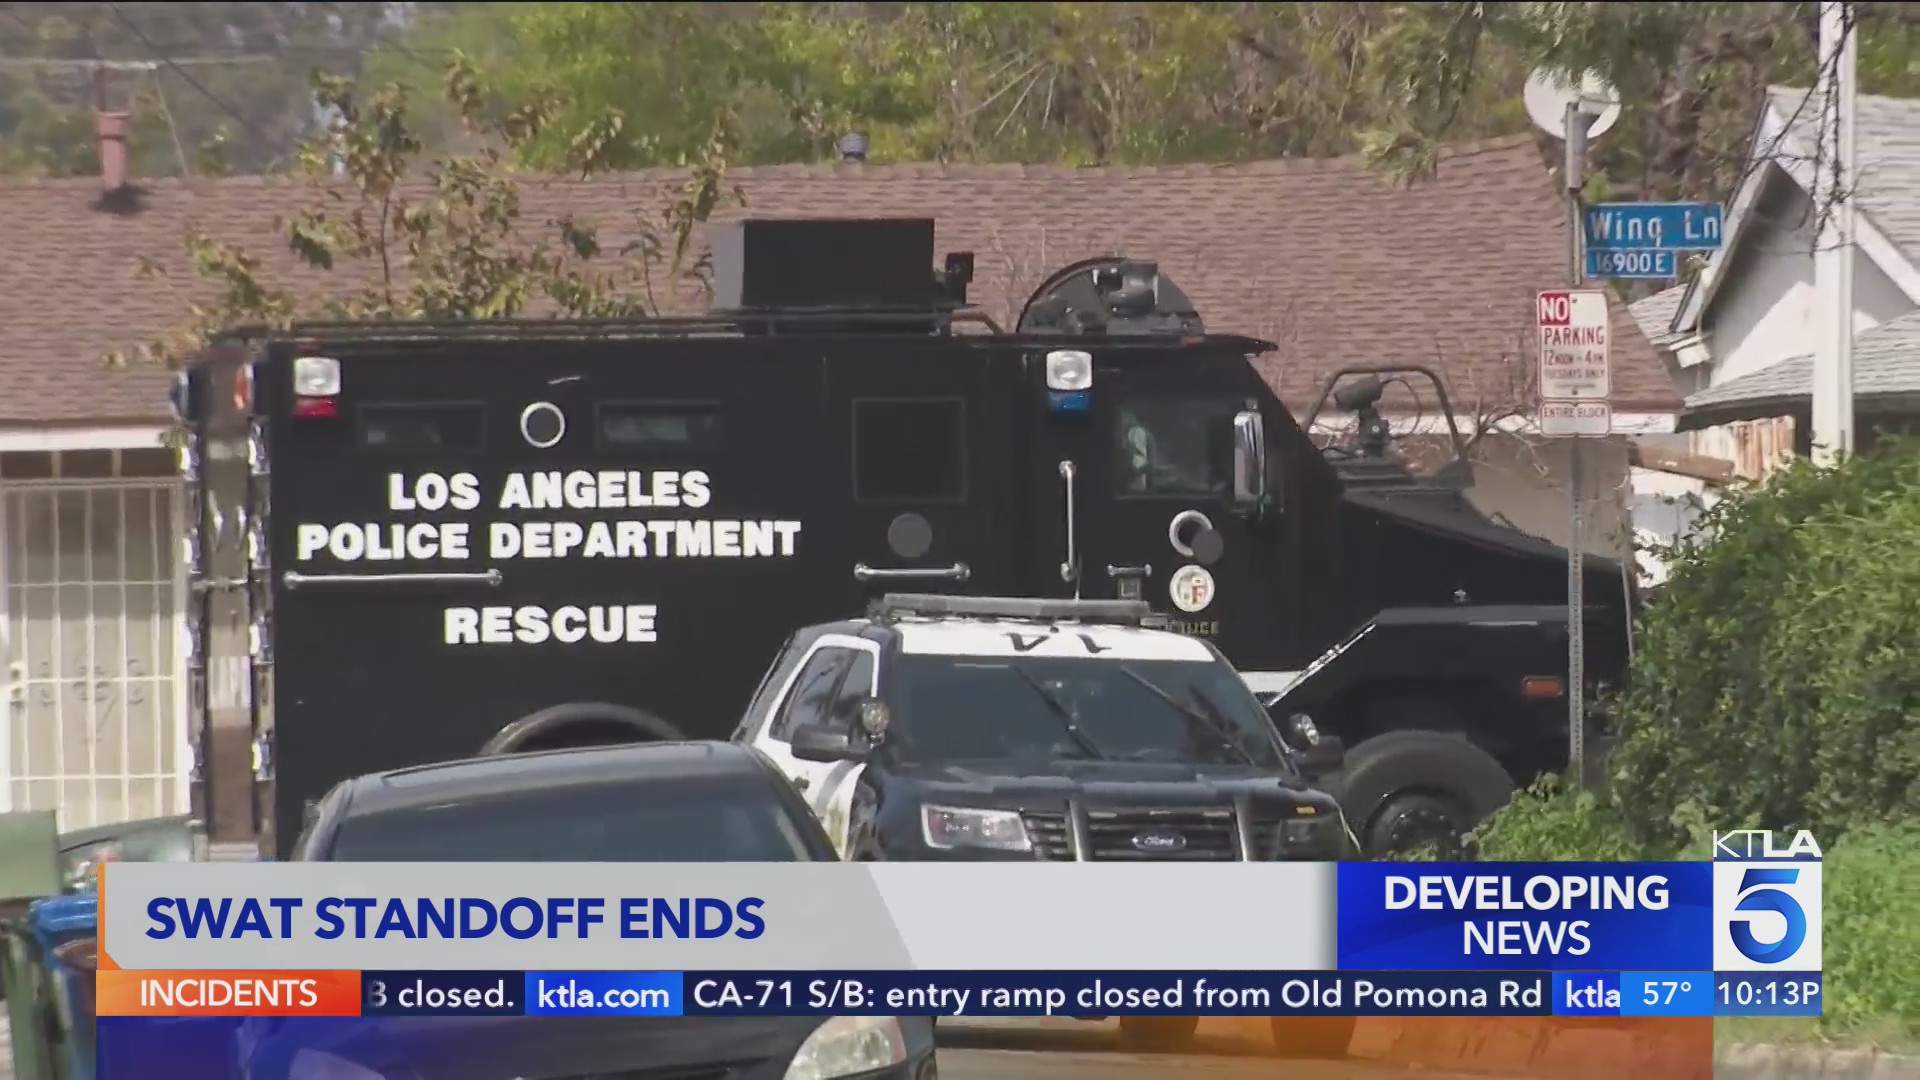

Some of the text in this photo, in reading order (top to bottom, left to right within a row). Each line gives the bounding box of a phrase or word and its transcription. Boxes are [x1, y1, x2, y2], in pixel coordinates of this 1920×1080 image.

[1590, 210, 1719, 247] Wing Ln
[1596, 253, 1666, 273] 16900 E
[1541, 297, 1567, 321] NO
[1544, 326, 1604, 345] PARKING
[1544, 407, 1606, 418] ENTIRE BLOCK
[388, 470, 711, 510] LOS ANGELES
[297, 520, 802, 560] POLICE DEPARTMENT
[443, 605, 658, 644] RESCUE
